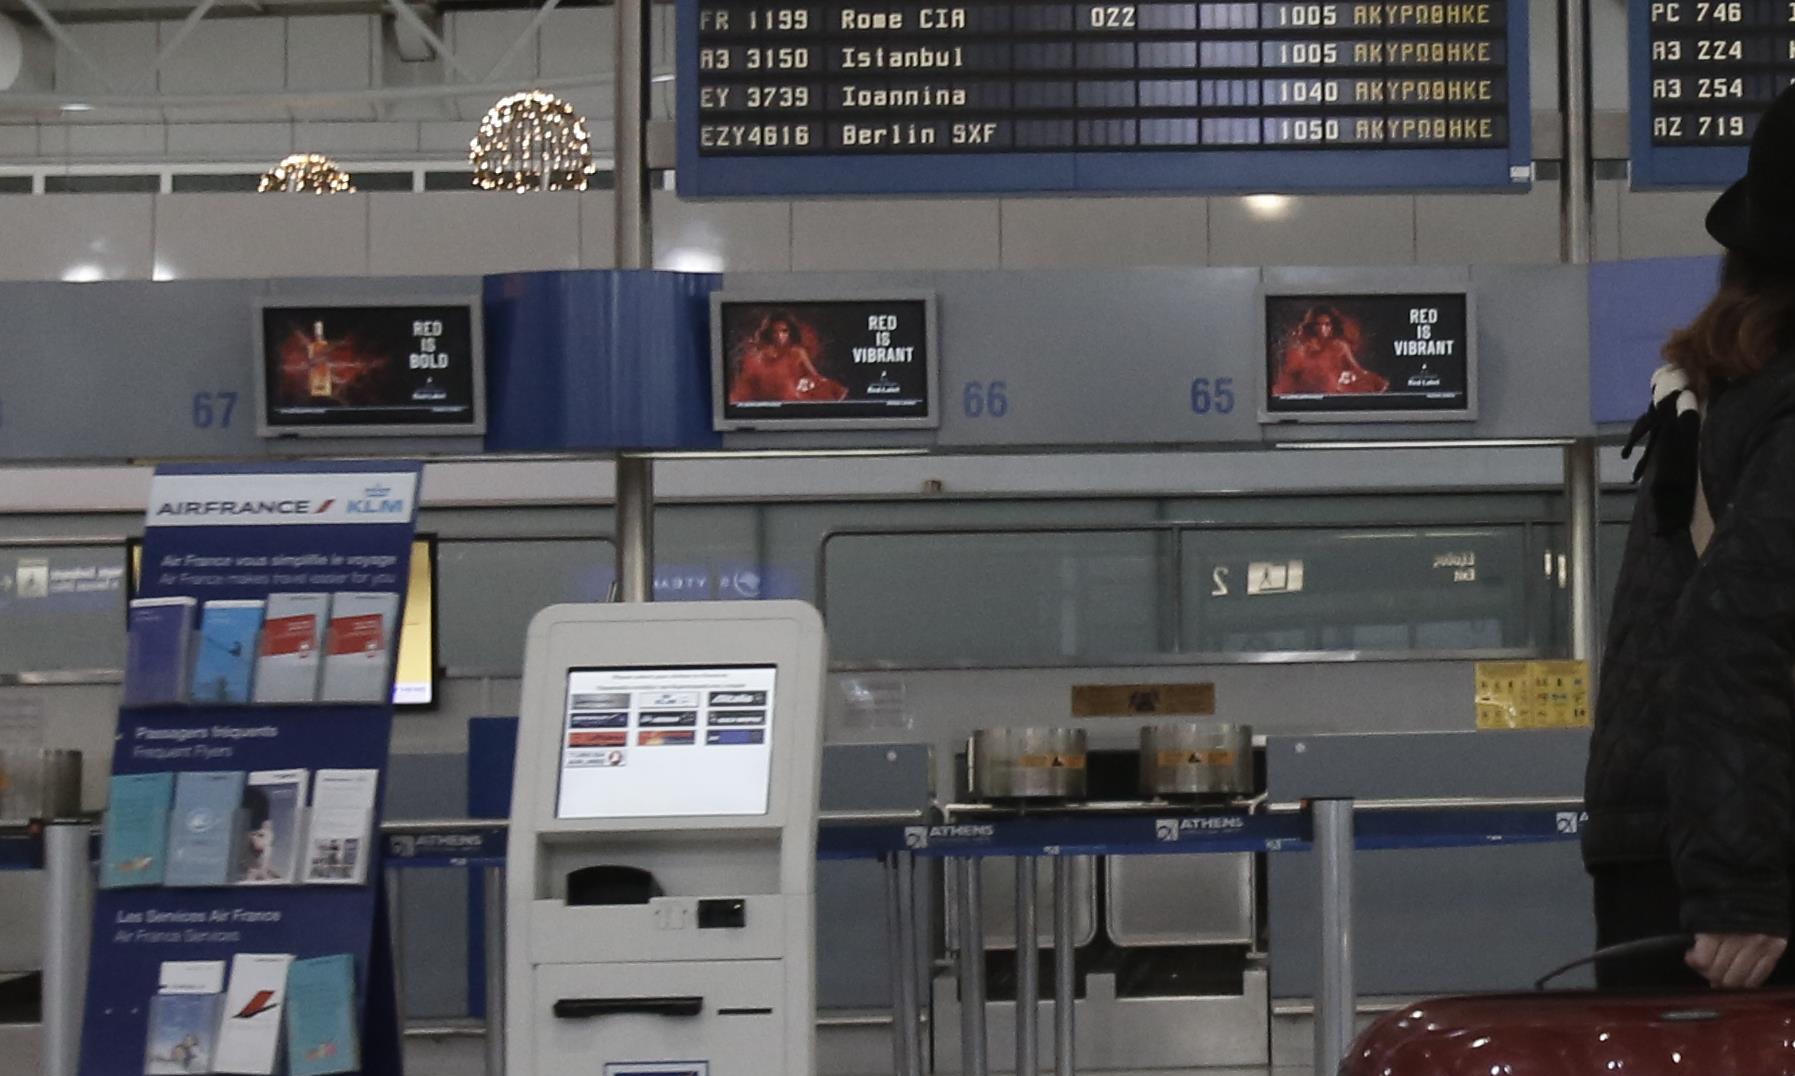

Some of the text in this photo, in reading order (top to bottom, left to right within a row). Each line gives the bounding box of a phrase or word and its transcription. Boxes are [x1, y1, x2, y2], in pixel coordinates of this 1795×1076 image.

[701, 5, 1338, 30] FR 1199 Rome CIA 022 1005
[1652, 3, 1680, 23] PC
[1697, 2, 1743, 22] 746
[701, 42, 1338, 70] A3 3150 Istanbul 1005
[1652, 40, 1681, 61] A3
[1697, 40, 1743, 60] 224
[701, 81, 1339, 108] EY 3739 Ioannina 1040
[1653, 78, 1682, 99] A3
[1697, 78, 1743, 98] 254
[701, 119, 1340, 147] EZY4616 Berlin SXF 1050
[1653, 116, 1682, 138] AZ
[1698, 116, 1744, 137] 719
[867, 314, 898, 331] RED
[1409, 308, 1438, 324] RED
[412, 320, 443, 337] RED
[1416, 325, 1431, 340] IS
[421, 337, 436, 352] IS
[875, 331, 891, 347] IS
[852, 347, 915, 364] VIBRANT
[1394, 340, 1455, 356] VIBRANT
[409, 352, 448, 369] BOLD
[962, 380, 1010, 418] 66
[1189, 376, 1236, 416] 65
[191, 391, 239, 430] 67
[156, 499, 404, 517] AIRFRANCE KLM
[160, 555, 181, 567] Air
[184, 554, 232, 567] France
[236, 556, 268, 567] vous
[929, 823, 995, 838] ATHENS
[1180, 817, 1245, 831] ATHENS
[208, 909, 229, 923] Air
[232, 908, 282, 922] France
